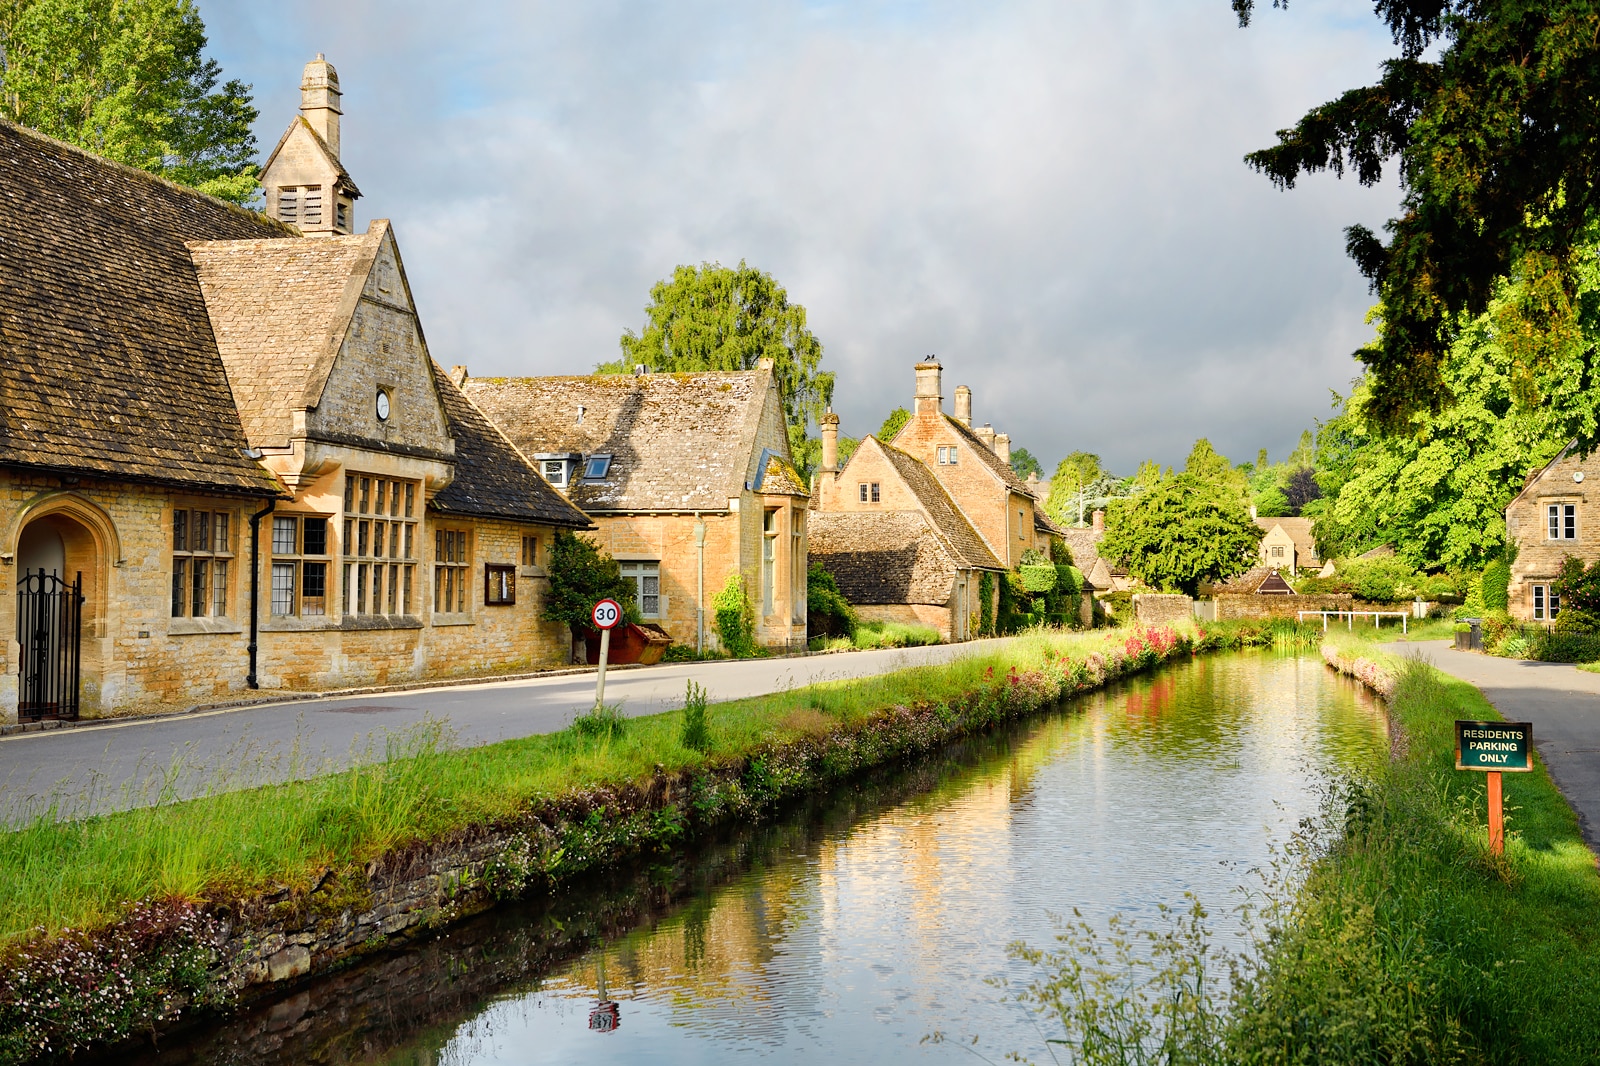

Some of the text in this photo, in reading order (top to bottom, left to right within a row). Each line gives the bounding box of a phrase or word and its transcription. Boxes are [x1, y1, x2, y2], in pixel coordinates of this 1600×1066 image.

[596, 608, 616, 620] 30
[1463, 730, 1523, 740] RESIDENTS
[1469, 741, 1517, 751] PARKING
[1479, 753, 1508, 763] ONLY
